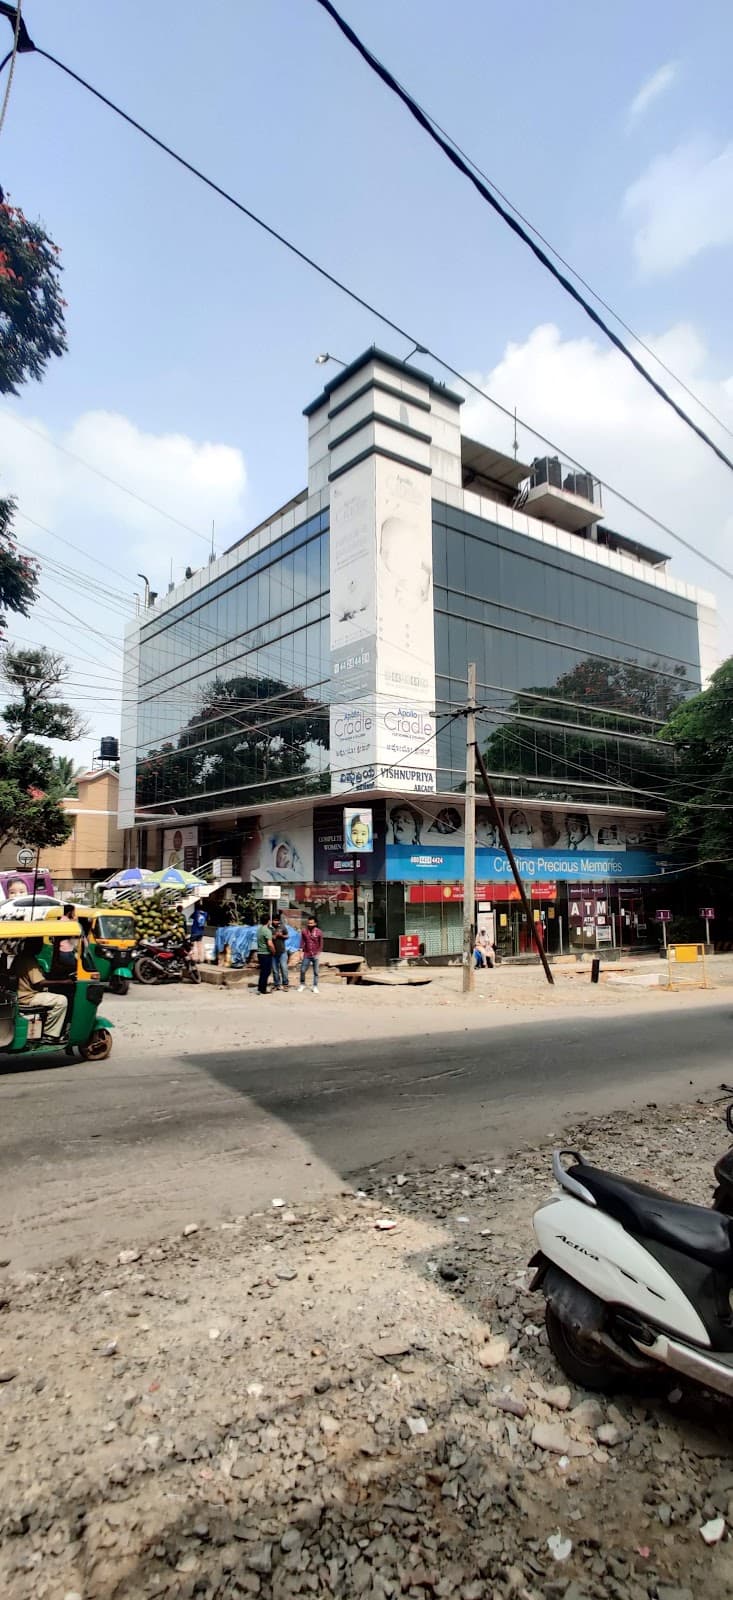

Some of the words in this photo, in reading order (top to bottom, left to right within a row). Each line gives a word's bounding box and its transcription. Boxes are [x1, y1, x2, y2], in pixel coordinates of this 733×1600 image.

[397, 707, 418, 719] Apollo
[334, 710, 372, 738] Cradle
[384, 711, 432, 736] Cradle
[381, 767, 434, 783] VISHNUPRIYA
[414, 784, 434, 793] ARCADE
[318, 835, 342, 843] COMPLETE
[493, 856, 535, 876] Crating
[537, 859, 579, 873] Precious
[580, 858, 622, 873] Memories
[570, 901, 606, 916] ATM
[554, 1235, 600, 1261] Activa
